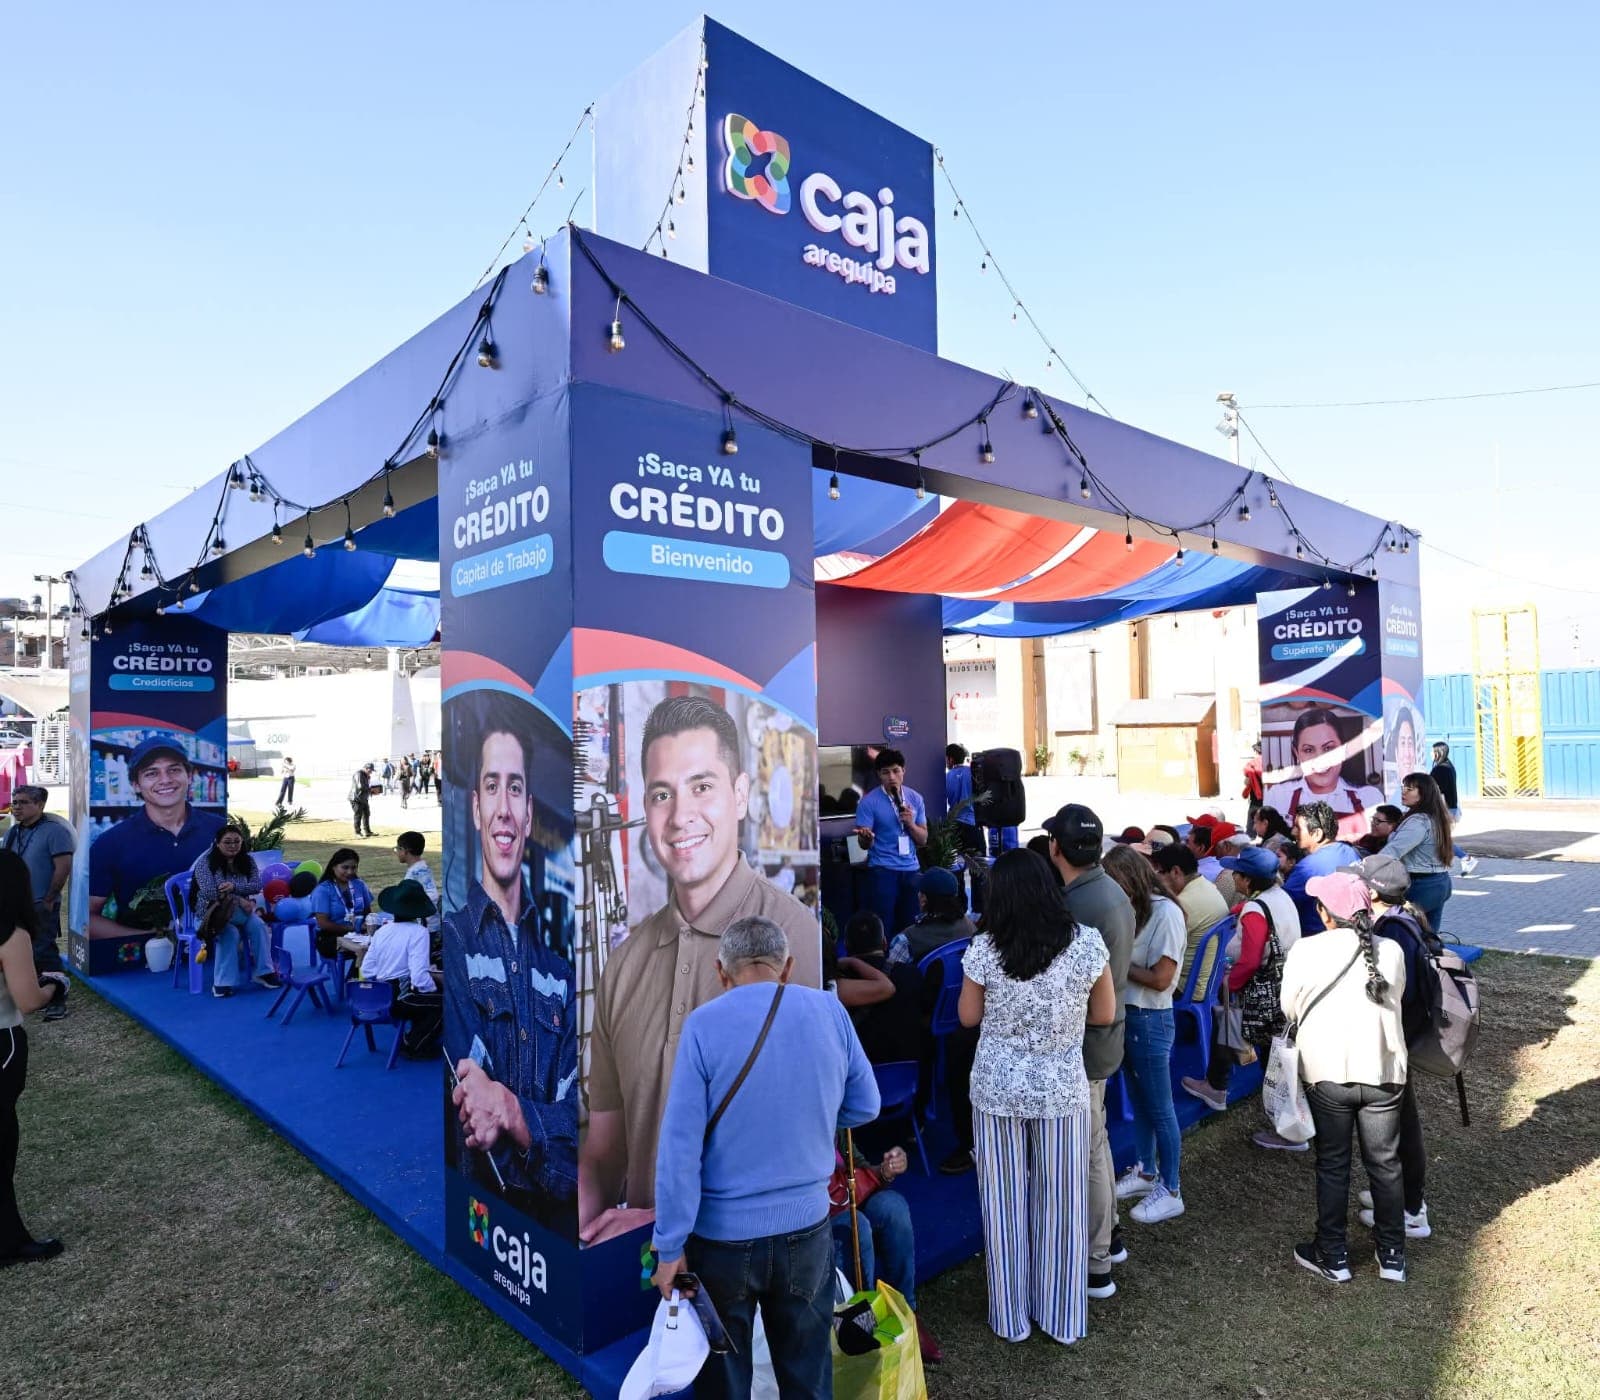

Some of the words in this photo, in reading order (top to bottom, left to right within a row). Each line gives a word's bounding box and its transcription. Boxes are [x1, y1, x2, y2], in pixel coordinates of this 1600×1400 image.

[800, 172, 929, 274] caja
[803, 244, 896, 294] arequipa
[465, 474, 498, 506] ¡Saca
[499, 465, 516, 486] YA
[519, 459, 533, 477] tu
[638, 453, 702, 483] ¡Saca
[708, 464, 734, 489] YA
[739, 472, 760, 494] tu
[453, 485, 550, 550] CRÉDITO
[609, 482, 785, 541] CRÉDITO
[456, 562, 489, 587] Capital
[490, 557, 504, 576] de
[506, 544, 547, 571] Trabajo
[651, 544, 753, 575] Bienvenido
[1273, 618, 1362, 640] CRÉDITO
[1319, 607, 1334, 616] YA
[1336, 606, 1349, 615] tu
[113, 652, 213, 673] CRÉDITO
[167, 643, 183, 653] YA
[186, 645, 199, 654] tu
[132, 677, 194, 688] Credioficios
[492, 1225, 547, 1294] caja
[493, 1269, 531, 1306] arequipa
